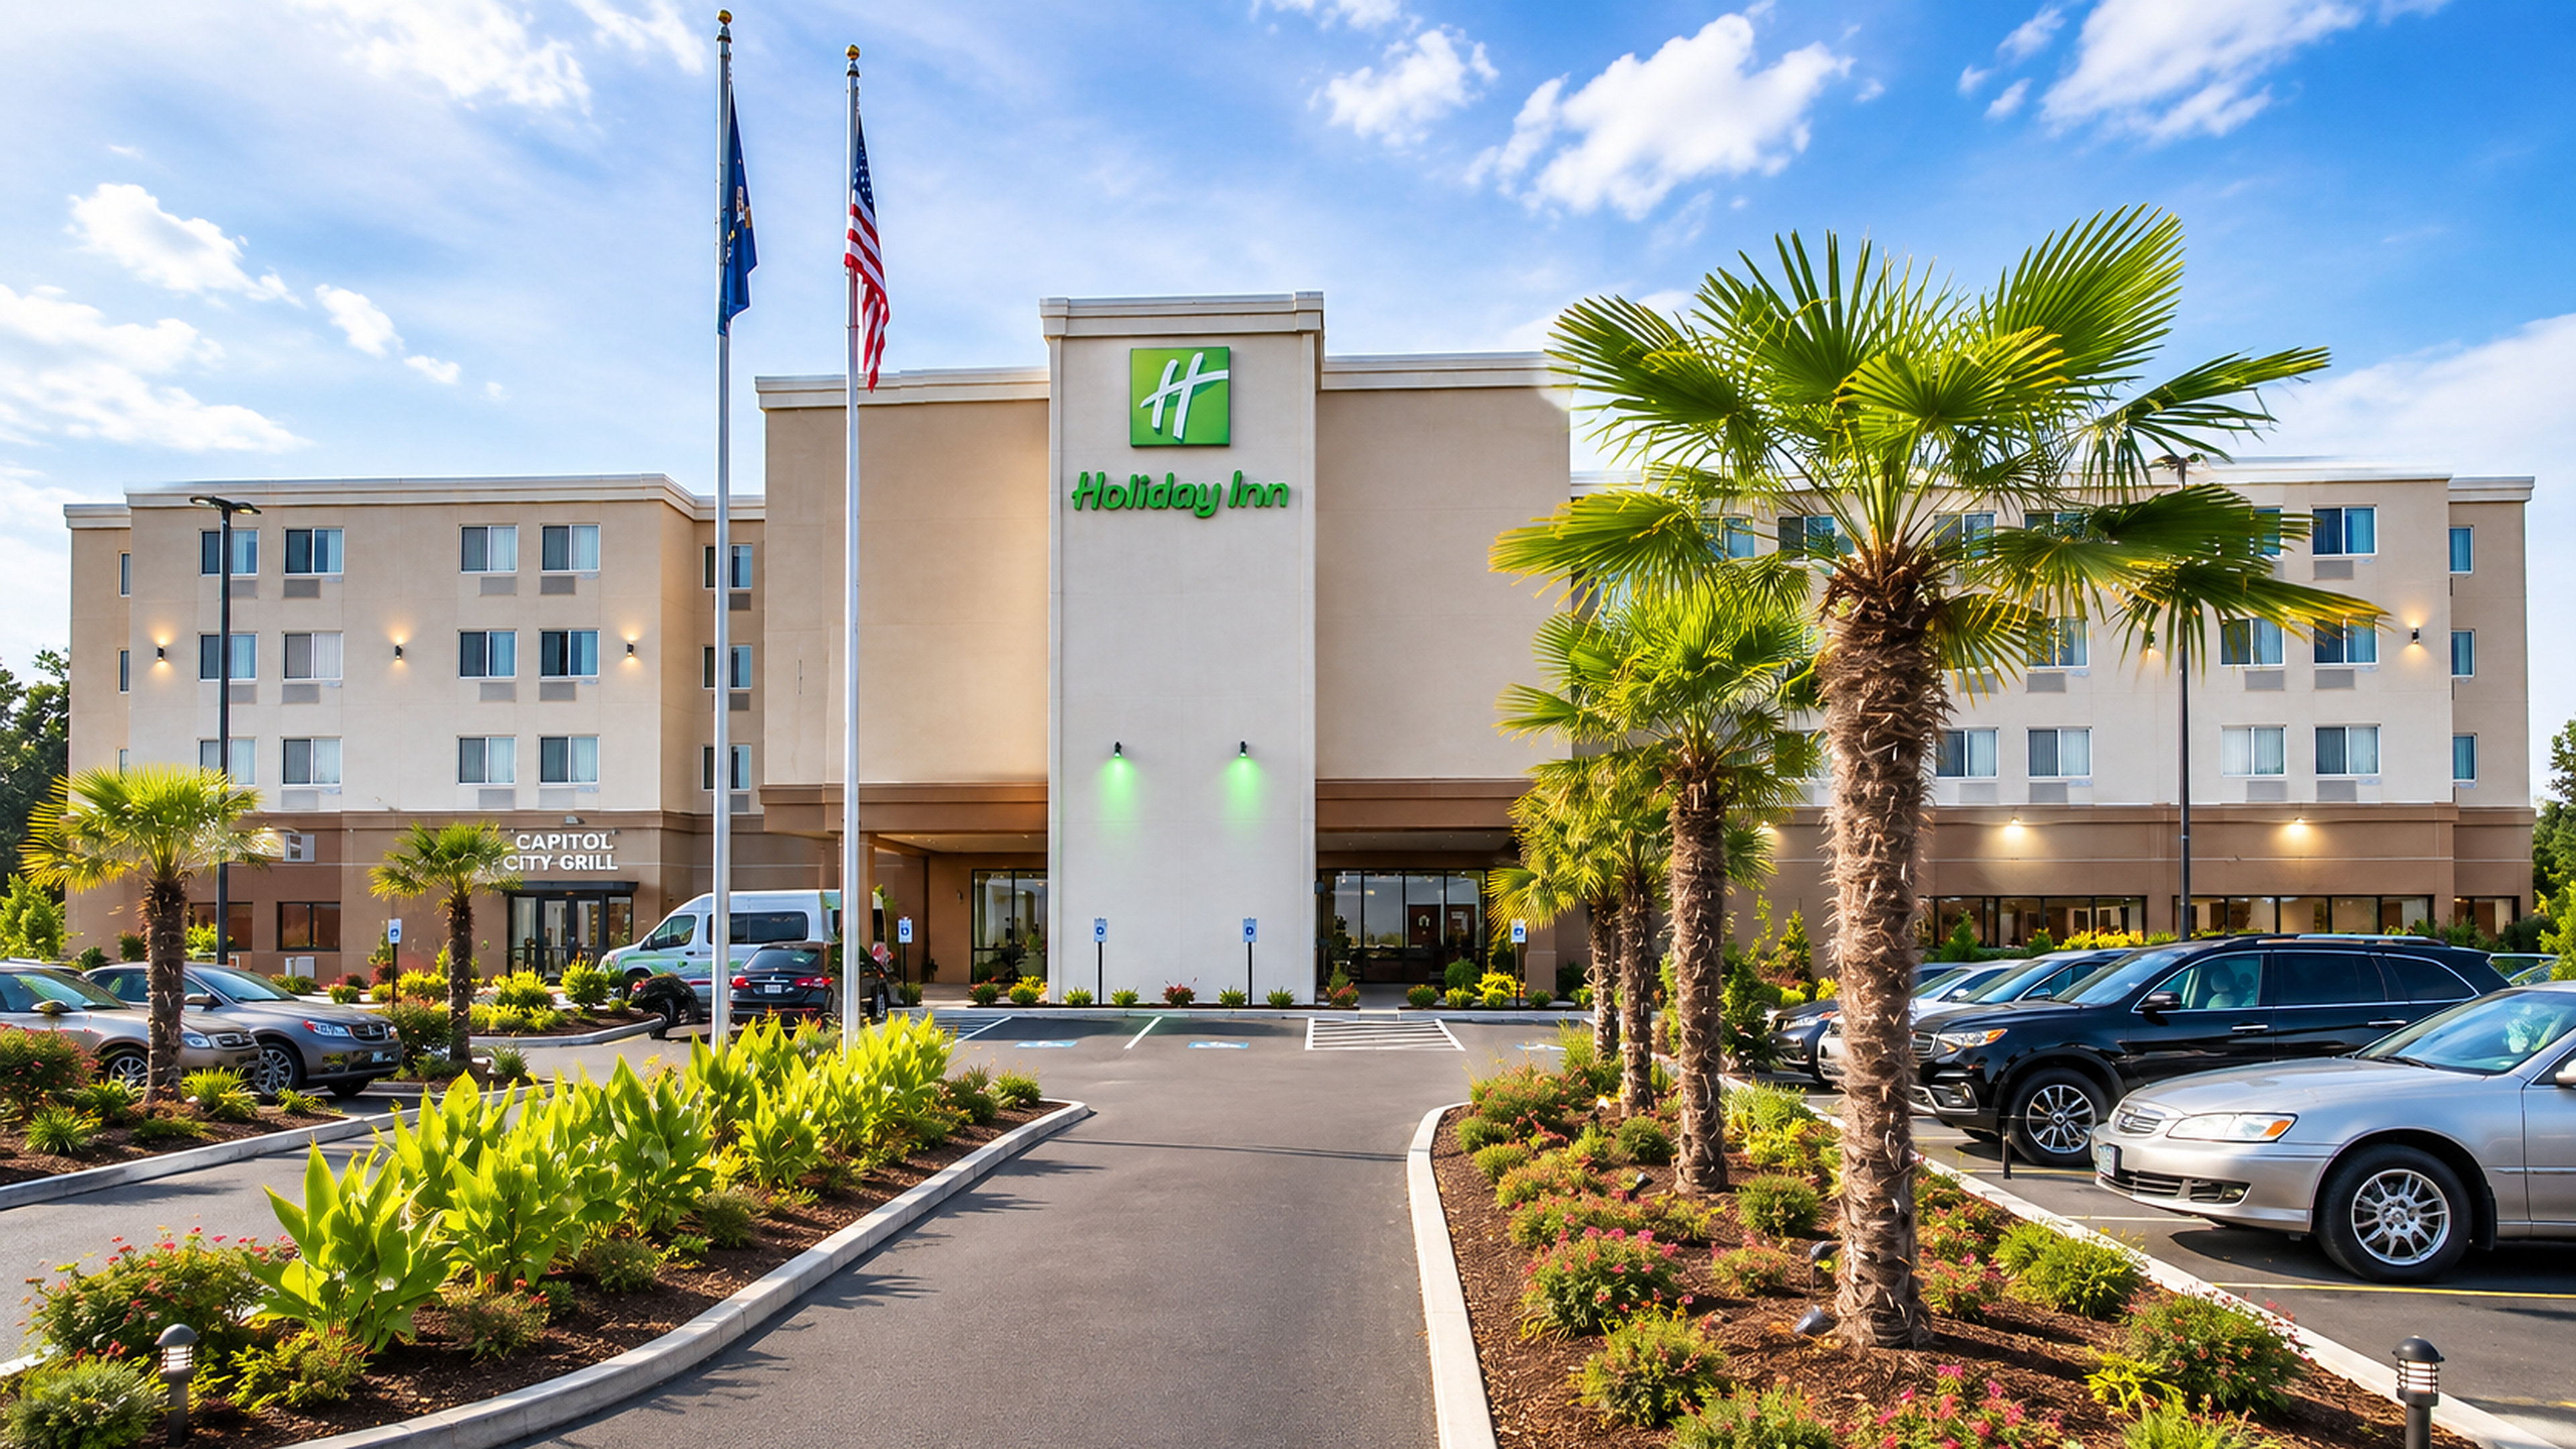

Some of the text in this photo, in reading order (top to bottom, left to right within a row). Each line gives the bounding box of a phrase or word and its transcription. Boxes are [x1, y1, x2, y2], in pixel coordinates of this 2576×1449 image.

[1140, 352, 1228, 439] H
[1072, 470, 1289, 518] Holiday Inn
[516, 833, 614, 850] CAPITOL
[503, 854, 619, 871] CITY GRILL
